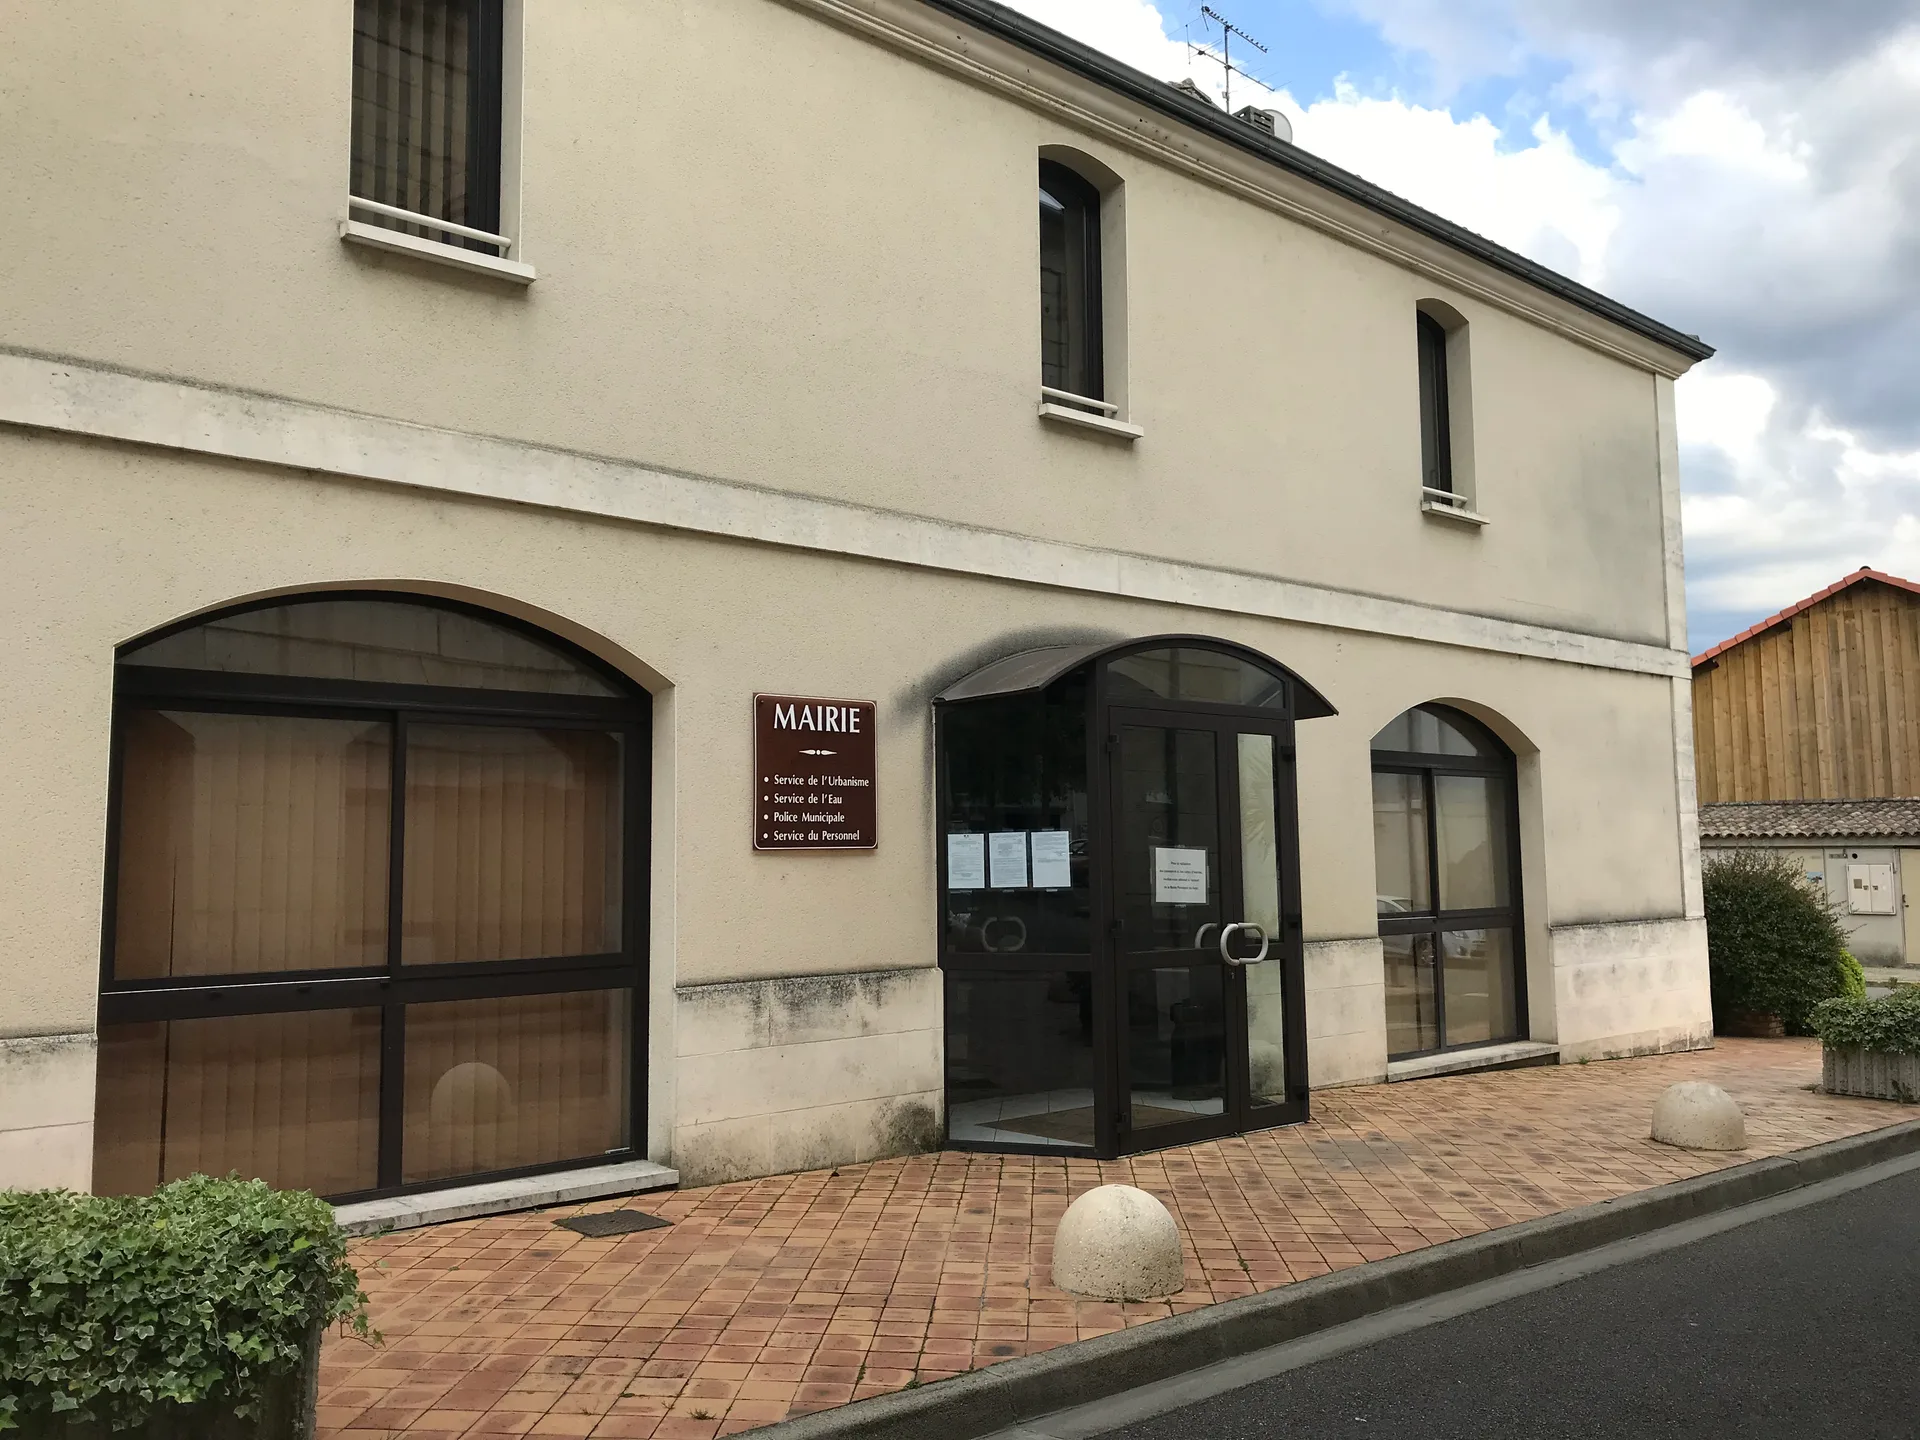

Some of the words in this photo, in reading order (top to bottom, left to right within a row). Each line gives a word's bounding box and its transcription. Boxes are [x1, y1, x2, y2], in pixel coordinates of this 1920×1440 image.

[774, 703, 860, 733] MAIRIE
[774, 775, 804, 785] Service
[808, 775, 818, 786] de
[821, 775, 869, 787] l'Urbanisme
[774, 793, 804, 804] Service
[808, 794, 818, 804] de
[821, 794, 842, 804] l'Eau
[774, 812, 798, 822] Police
[802, 812, 845, 824] Municipale
[774, 831, 804, 841] Service
[808, 830, 818, 841] du
[822, 830, 860, 841] Personnel
